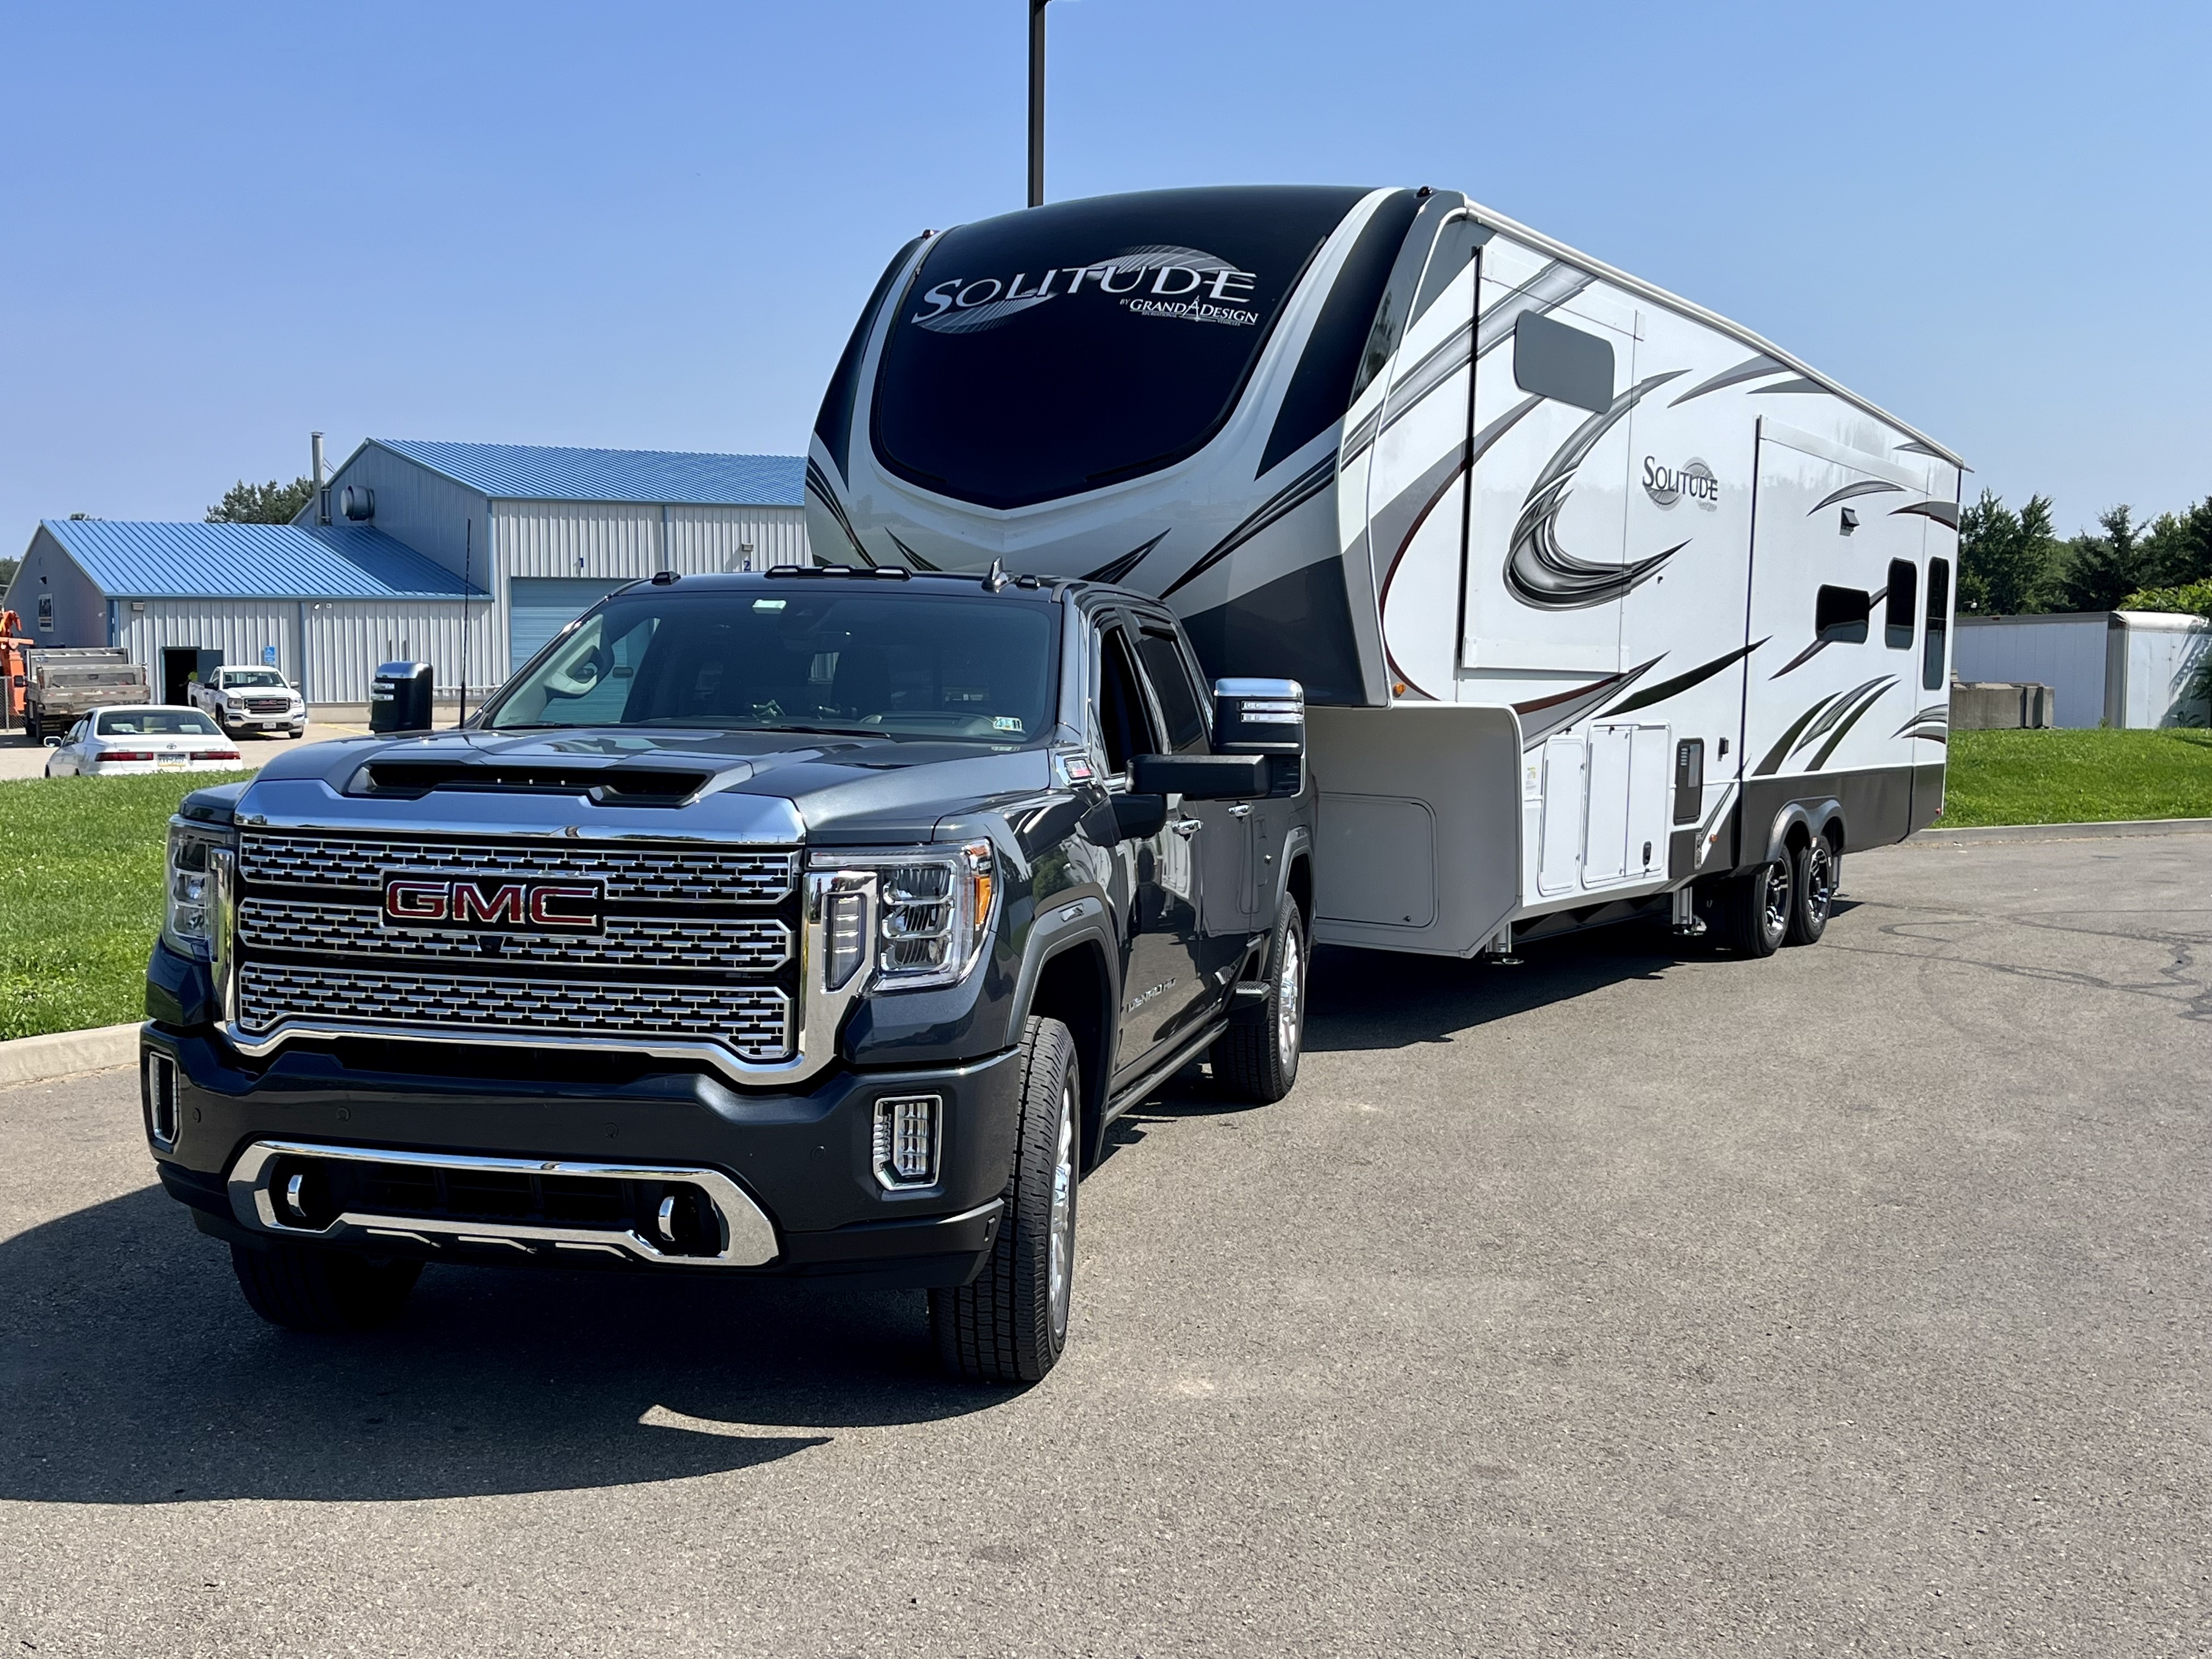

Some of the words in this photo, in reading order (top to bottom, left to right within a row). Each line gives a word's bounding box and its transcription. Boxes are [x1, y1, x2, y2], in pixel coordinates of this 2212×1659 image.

[911, 266, 1257, 324] SOLITUDE
[1130, 298, 1187, 313] GRAND
[1199, 304, 1260, 324] DESIGN
[1642, 455, 1718, 501] SOLITUDE
[579, 557, 584, 568] 1
[743, 560, 751, 571] 2
[386, 879, 598, 927] GMC
